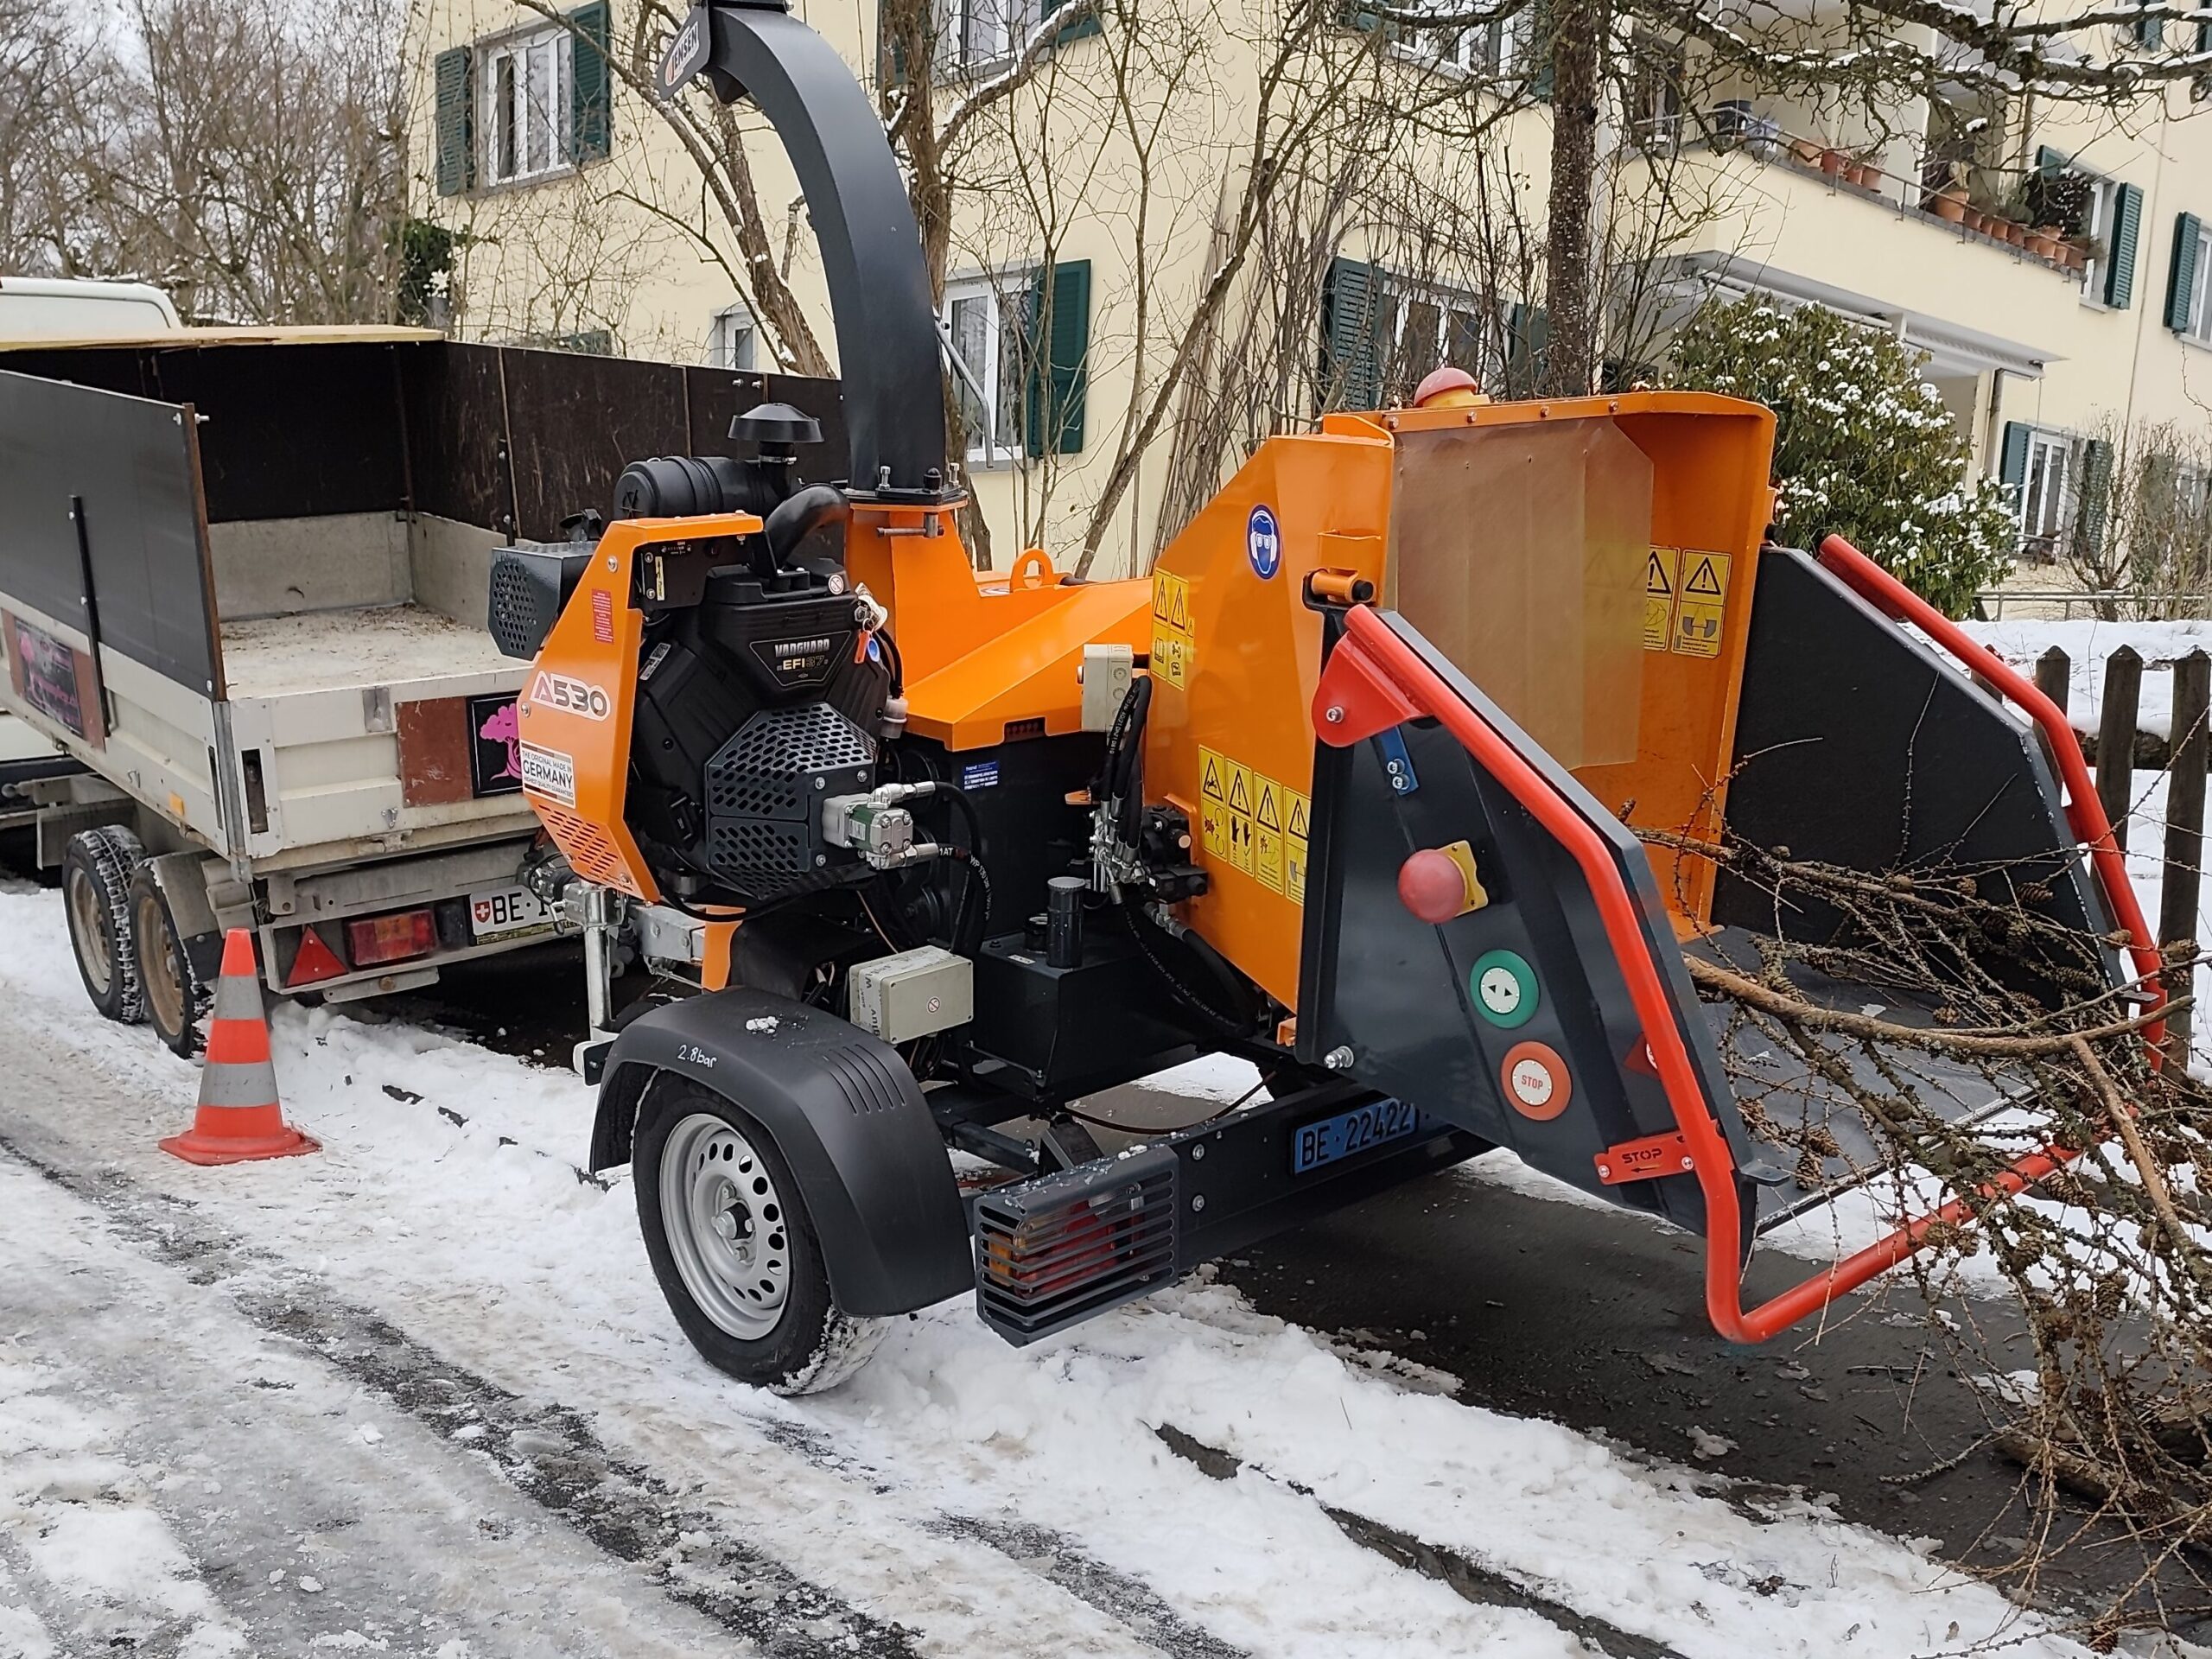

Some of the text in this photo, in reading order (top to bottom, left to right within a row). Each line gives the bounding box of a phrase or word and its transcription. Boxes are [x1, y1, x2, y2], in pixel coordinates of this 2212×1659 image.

[775, 639, 830, 657] VANGUARD
[783, 658, 805, 671] EFI
[533, 675, 607, 718] A530
[522, 750, 531, 759] THE
[523, 759, 573, 790] GERMANY
[492, 892, 524, 925] BE
[1521, 1074, 1544, 1090] STOP
[1301, 1101, 1411, 1166] BE 22422
[1621, 1147, 1662, 1164] STOP
